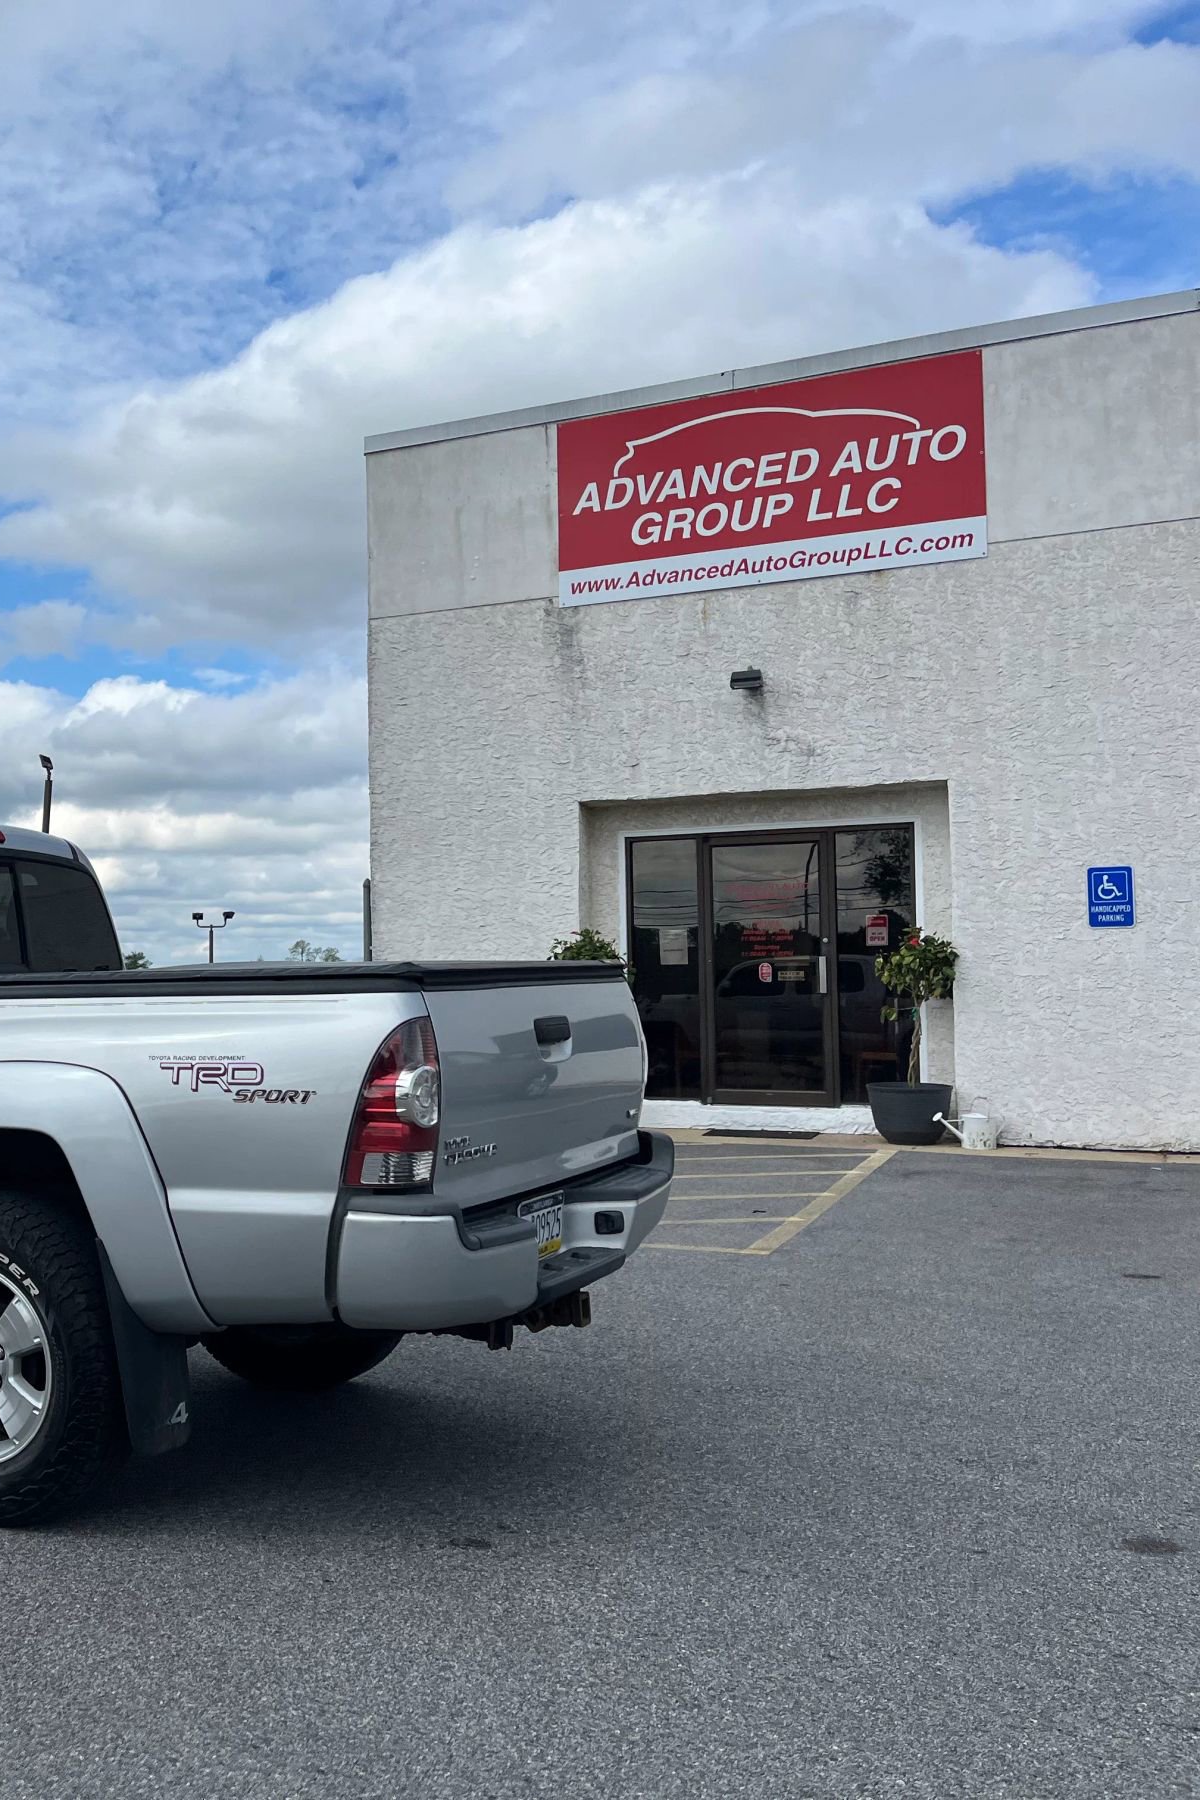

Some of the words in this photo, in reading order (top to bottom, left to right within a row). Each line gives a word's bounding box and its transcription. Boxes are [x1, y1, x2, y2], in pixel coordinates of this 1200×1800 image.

[572, 448, 820, 516] ADVANCED
[829, 424, 967, 477] AUTO
[631, 493, 794, 546] GROUP
[806, 477, 902, 523] LLC
[570, 532, 974, 595] www.AdvancedAutoGroupLLC.com
[1090, 905, 1131, 913] HANDICAPPED
[160, 1062, 264, 1093] TRD
[232, 1088, 313, 1105] SPORT
[531, 1206, 562, 1245] 09525
